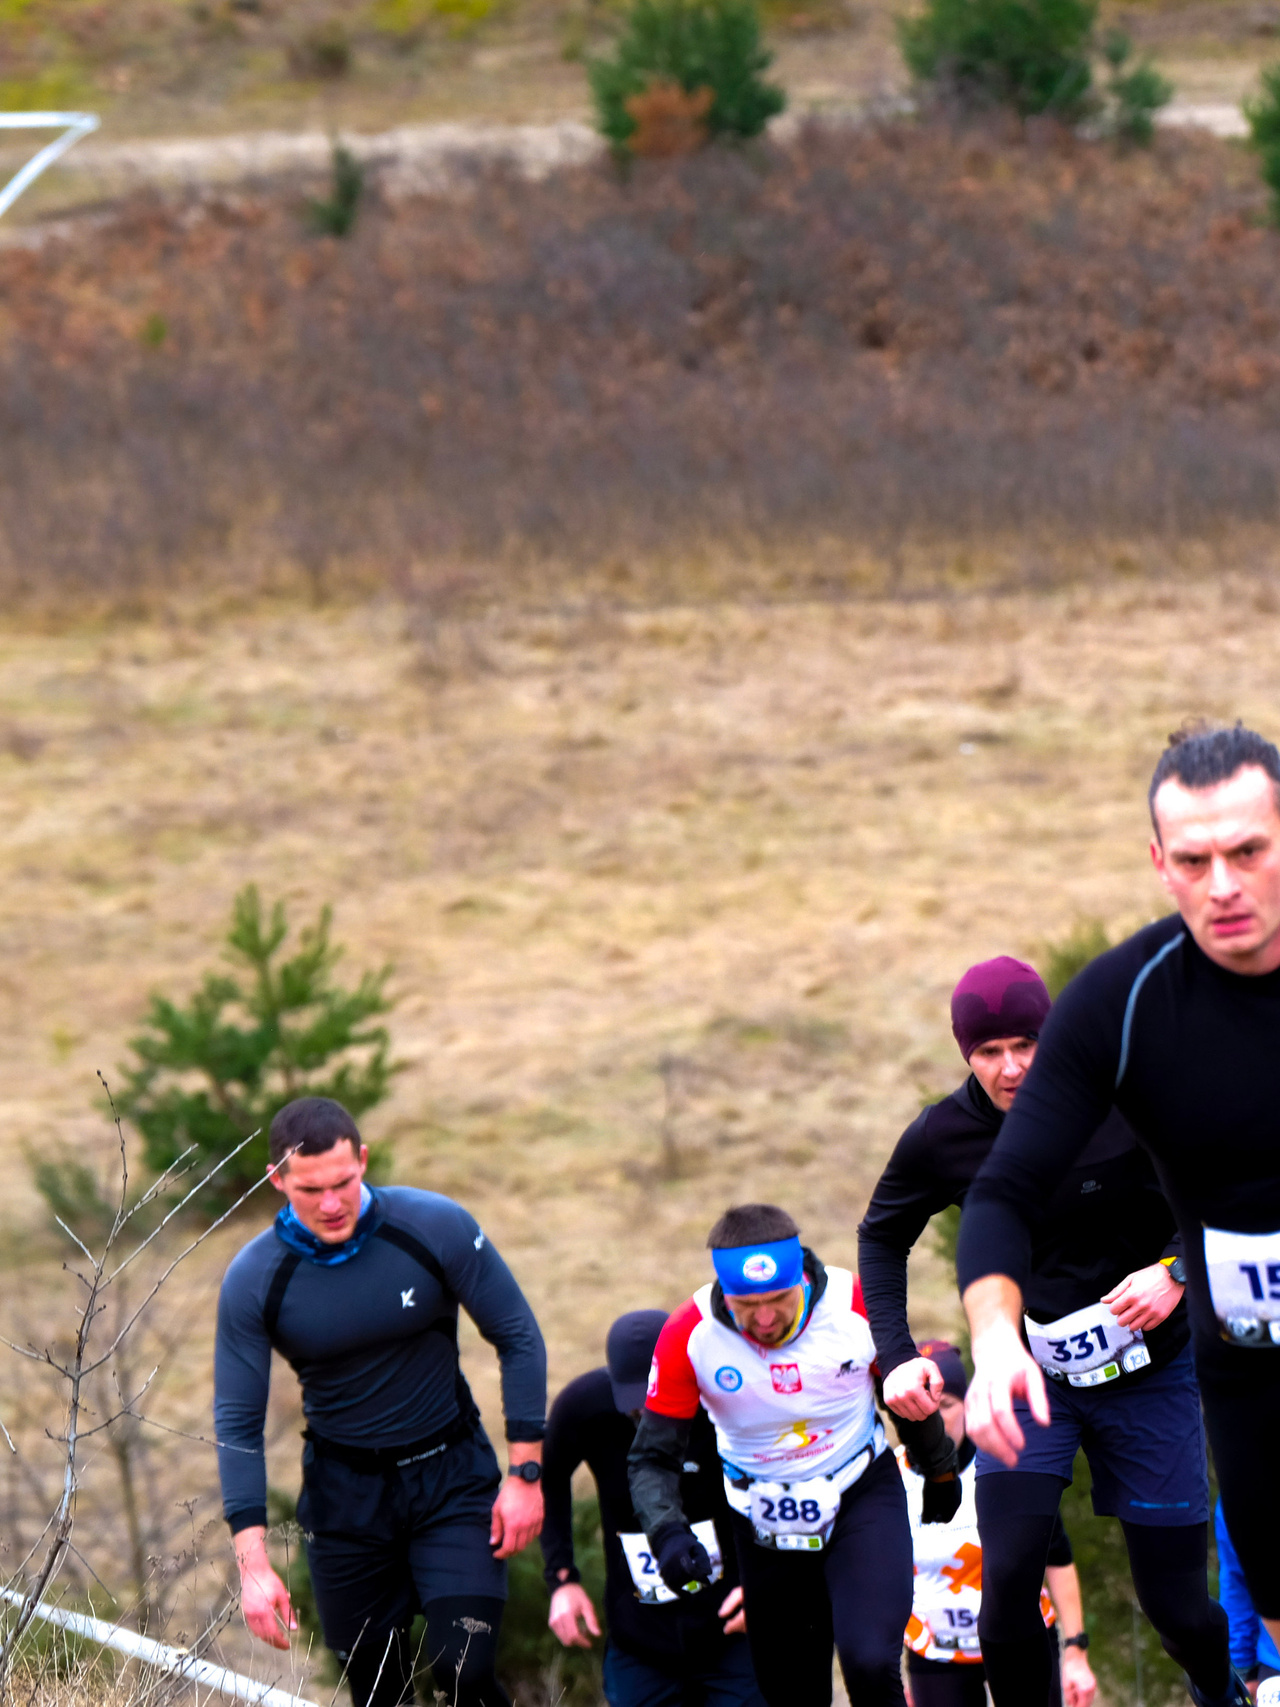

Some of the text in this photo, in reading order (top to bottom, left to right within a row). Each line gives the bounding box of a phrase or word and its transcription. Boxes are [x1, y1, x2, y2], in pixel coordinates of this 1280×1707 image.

[1047, 1324, 1109, 1362] 331
[760, 1496, 820, 1522] 288
[637, 1552, 659, 1574] 2
[943, 1608, 979, 1628] 15
